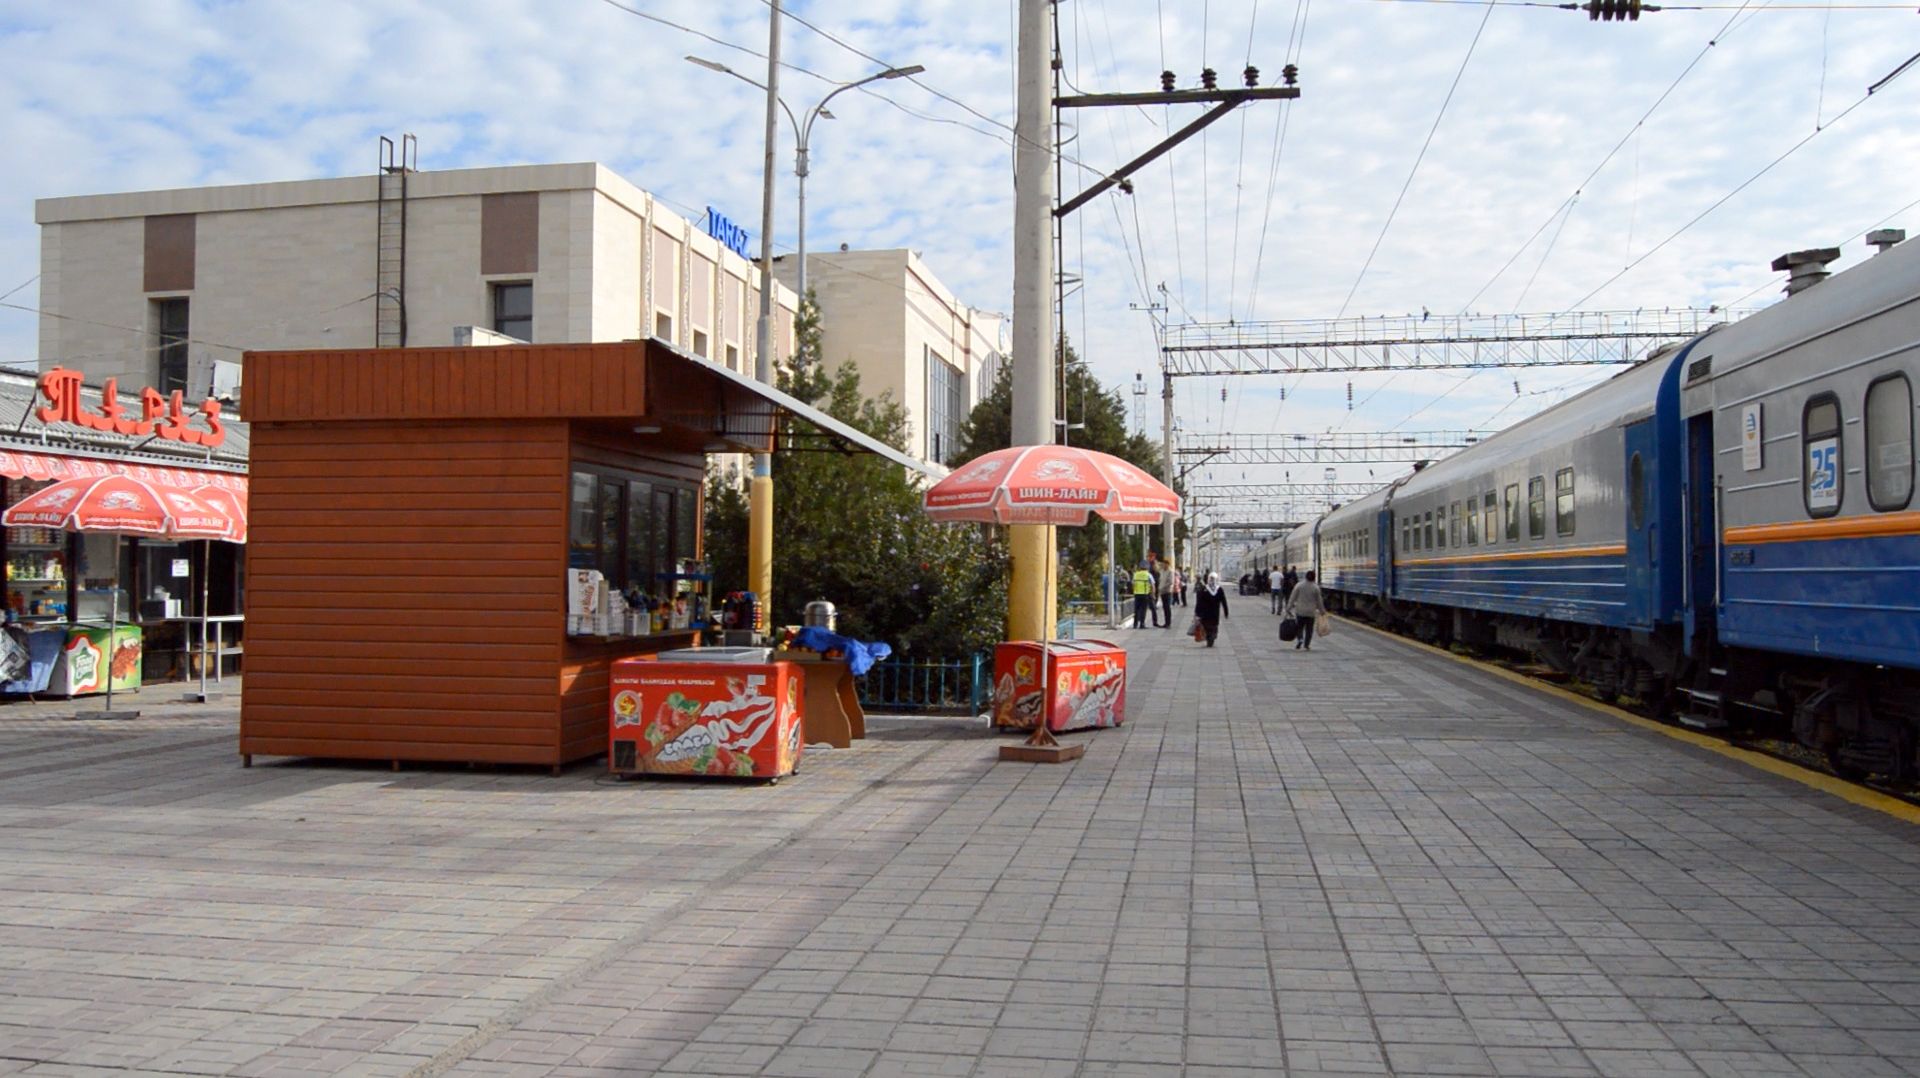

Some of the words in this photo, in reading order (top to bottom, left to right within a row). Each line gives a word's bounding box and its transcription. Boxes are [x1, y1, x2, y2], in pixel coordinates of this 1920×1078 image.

[706, 205, 749, 260] TARAZ
[1812, 447, 1837, 489] 25
[1019, 487, 1098, 500] ШИН-ЛАЙН
